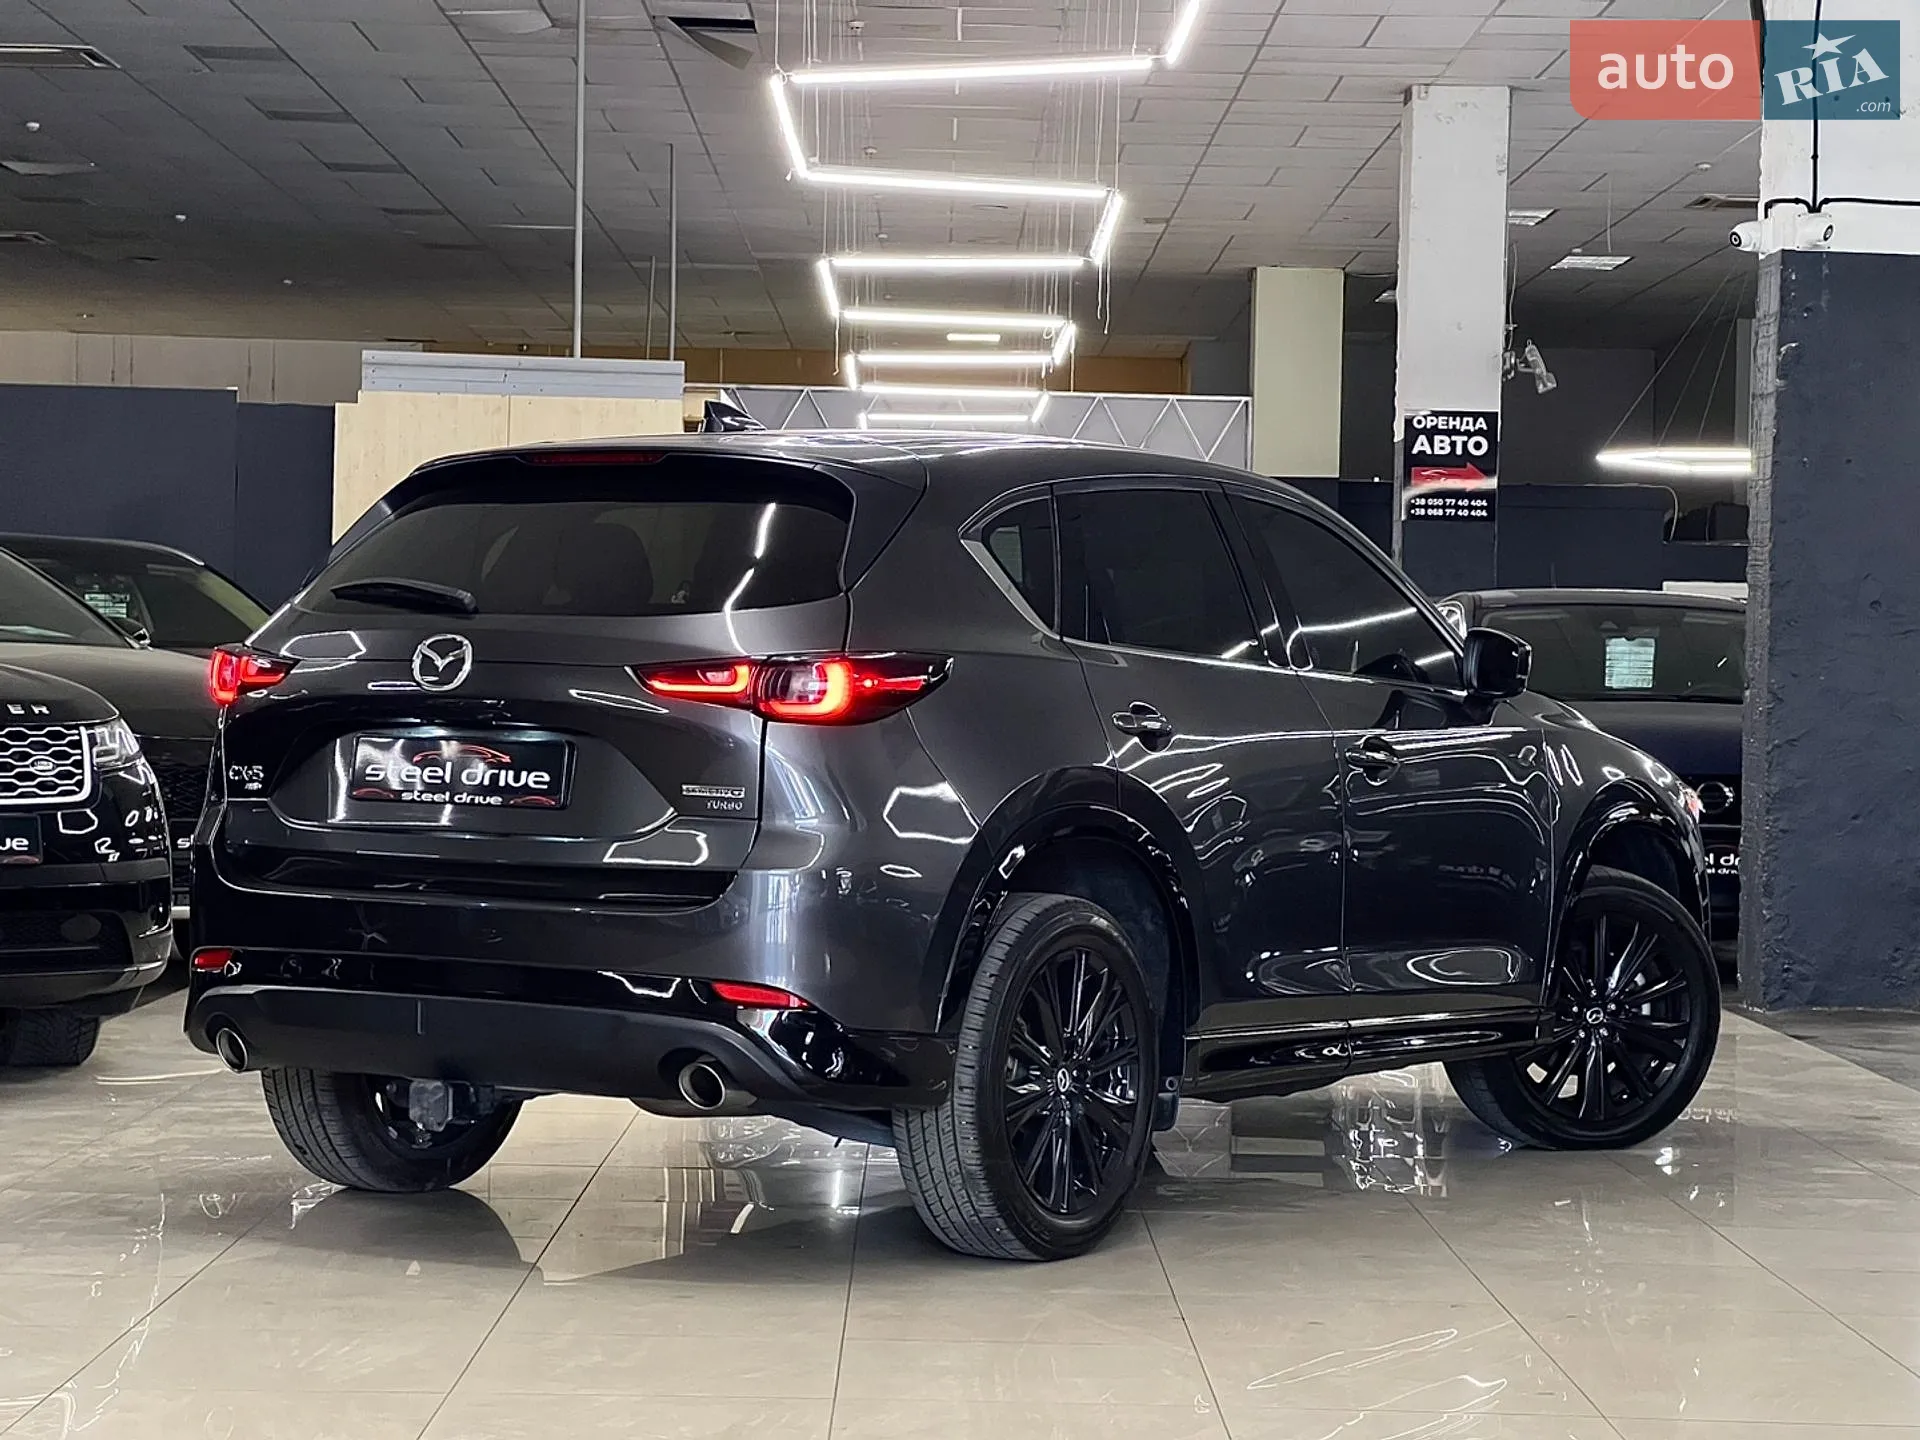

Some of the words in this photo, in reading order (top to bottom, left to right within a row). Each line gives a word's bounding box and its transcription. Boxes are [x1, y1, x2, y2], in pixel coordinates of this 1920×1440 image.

[1412, 415, 1488, 432] ОРЕНДА
[1411, 434, 1489, 456] АВТО
[1444, 498, 1456, 506] 77
[1457, 498, 1470, 507] 40
[1470, 499, 1488, 507] 404
[1444, 508, 1456, 516] 77
[1457, 509, 1469, 517] 40
[1470, 509, 1488, 517] 404
[365, 761, 452, 784] steel
[460, 762, 551, 789] drive
[401, 790, 450, 803] steel
[453, 792, 503, 805] drive
[706, 799, 743, 811] TURBO
